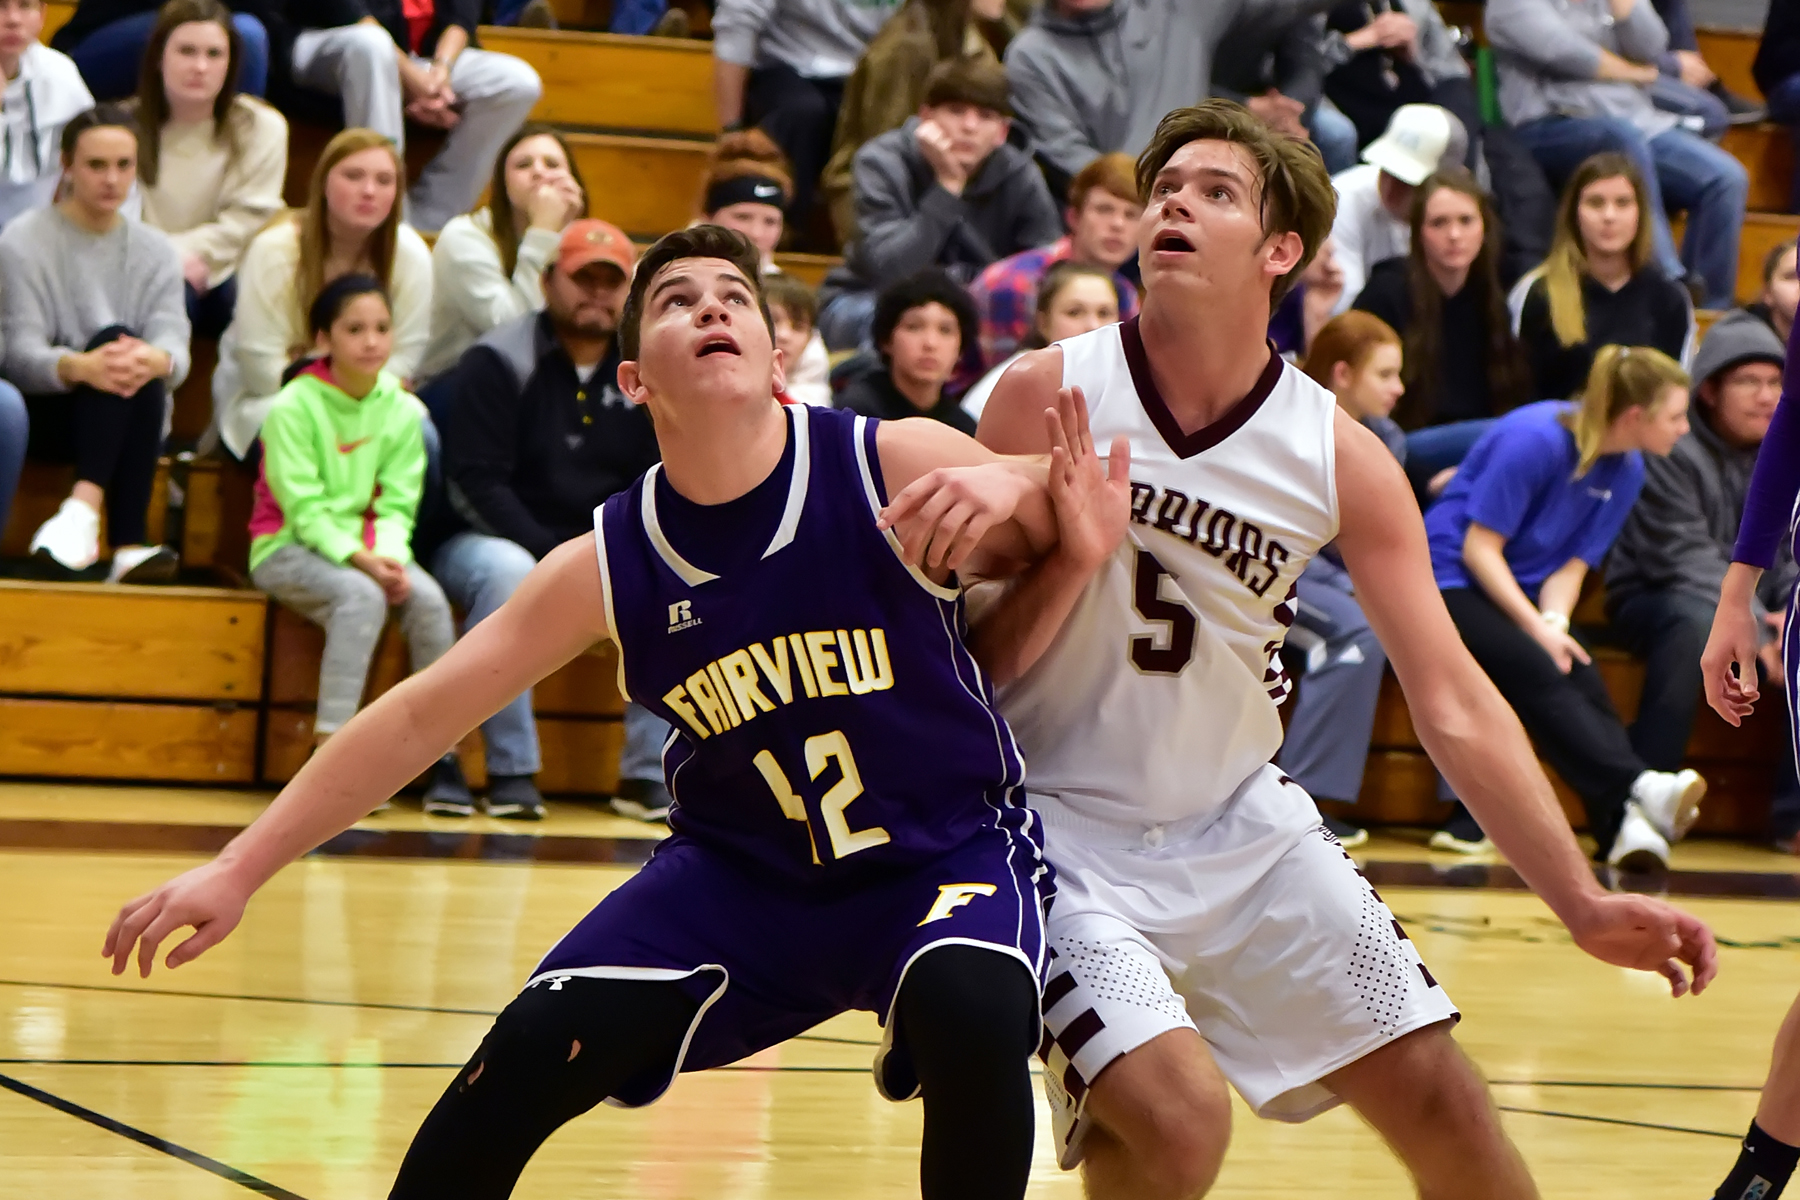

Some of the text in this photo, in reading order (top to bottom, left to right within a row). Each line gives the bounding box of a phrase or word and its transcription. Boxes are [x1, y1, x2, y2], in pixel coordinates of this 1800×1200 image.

[1127, 549, 1200, 678] 5
[662, 628, 895, 740] FAIRVIEW
[916, 882, 998, 927] F
